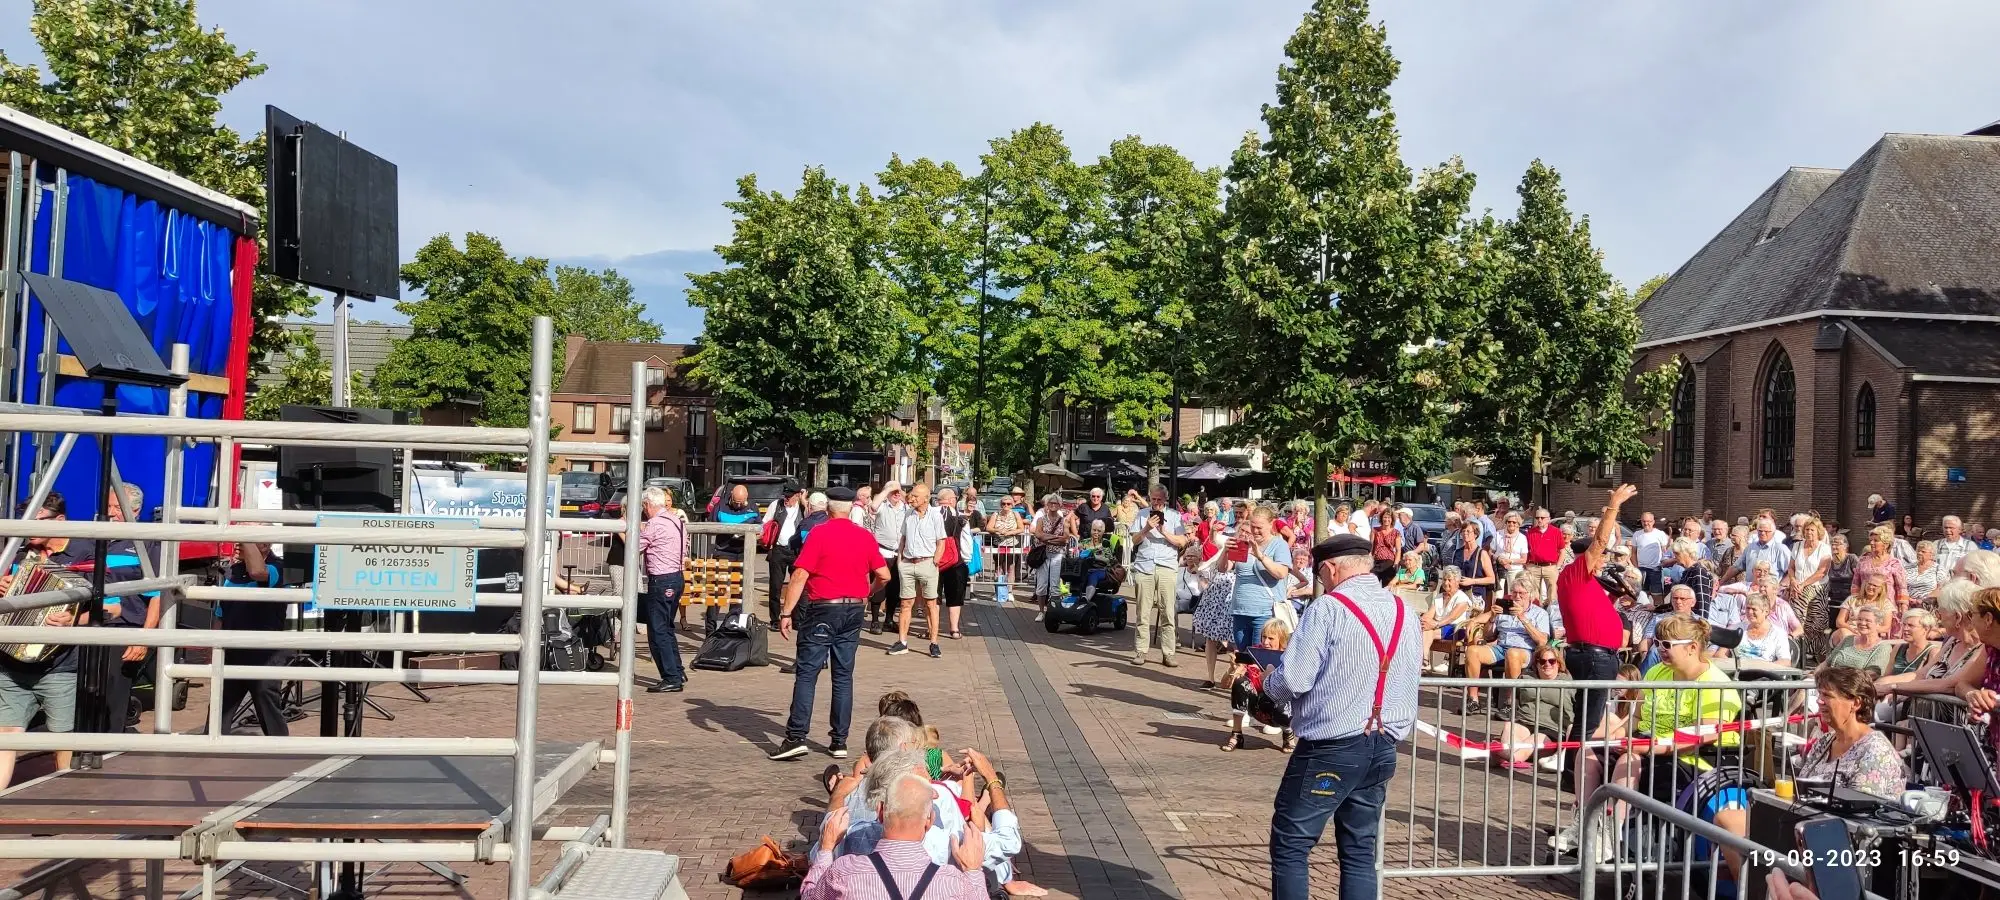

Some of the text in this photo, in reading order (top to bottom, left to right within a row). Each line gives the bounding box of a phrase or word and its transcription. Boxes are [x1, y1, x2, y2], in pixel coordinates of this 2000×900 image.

[362, 519, 435, 529] ROLSTEIGERS
[318, 545, 328, 584] TRAPPE
[365, 558, 430, 567] 06 12673535
[464, 547, 474, 588] ADDERS
[355, 570, 438, 587] PUTTEN
[333, 597, 457, 608] REPARATIE EN KEURING
